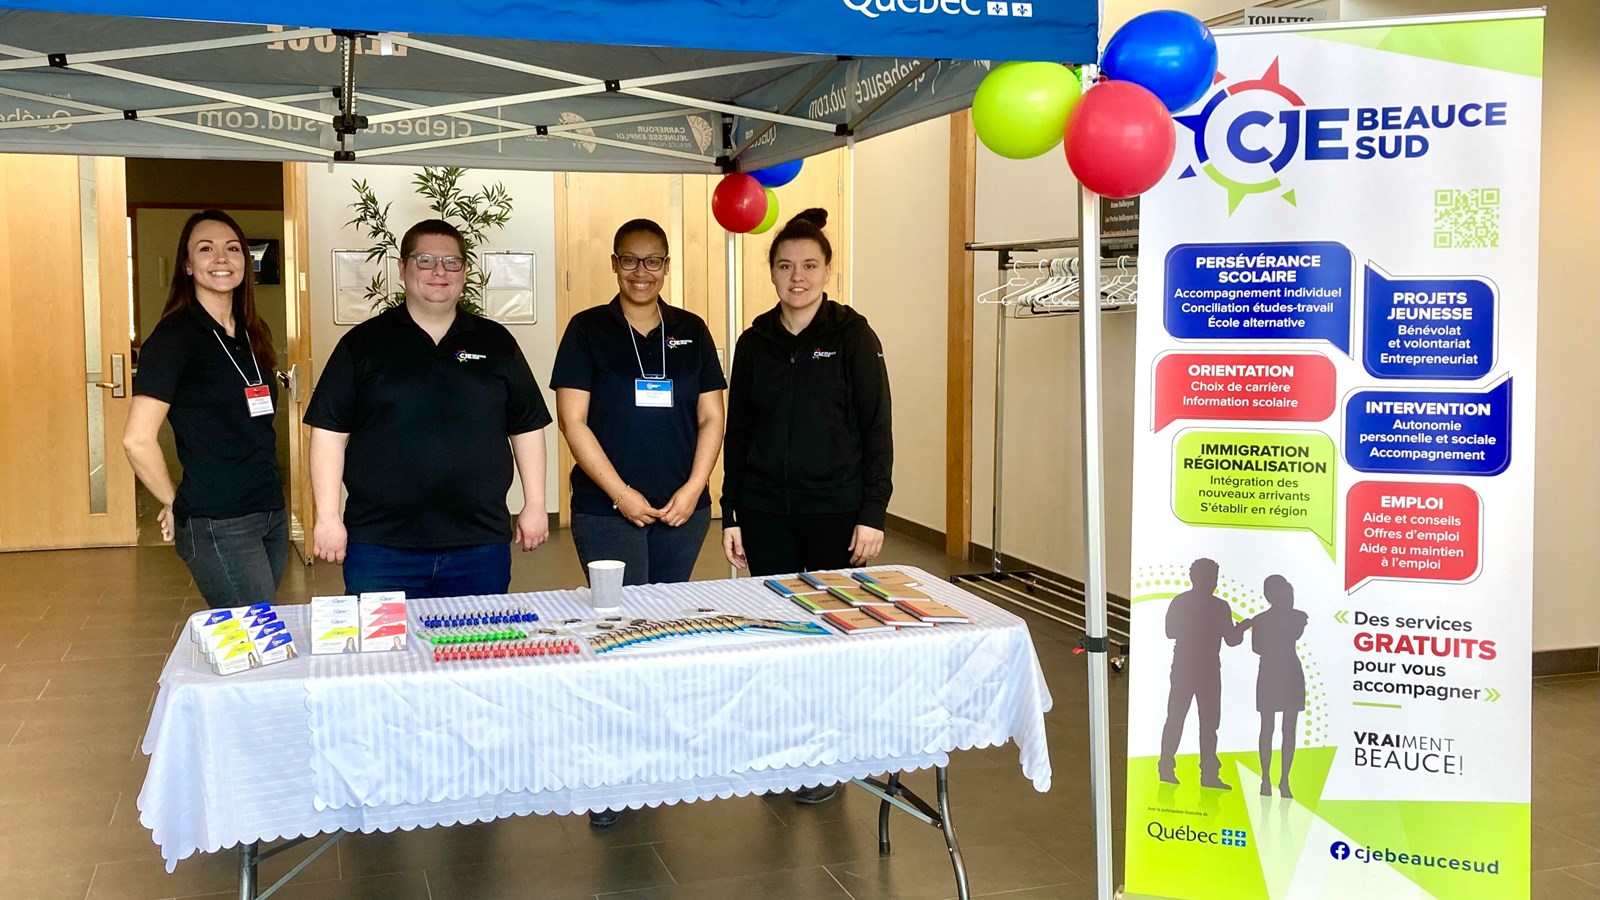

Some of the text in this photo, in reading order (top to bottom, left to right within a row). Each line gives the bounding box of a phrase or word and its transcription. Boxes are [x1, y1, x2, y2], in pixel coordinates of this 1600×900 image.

[1356, 101, 1507, 131] BEAUCE
[1226, 107, 1349, 174] CJE
[1355, 134, 1430, 160] SUD
[1195, 253, 1321, 269] PERSÉVÉRANCE
[1218, 269, 1297, 284] SCOLAIRE
[1174, 286, 1342, 300] Accompagnement individuel
[1393, 292, 1468, 306] PROJETS
[1181, 300, 1334, 314] Conciliation études-travail
[1387, 306, 1473, 321] JEUNESSE
[1207, 315, 1306, 328] École alternative
[1397, 323, 1462, 336] Bénévolat
[1388, 338, 1471, 349] et volontariat
[1380, 352, 1479, 366] Entrepreneuriat
[1188, 364, 1294, 378] ORIENTATION
[1190, 380, 1291, 393] Choix de carrière
[1182, 396, 1299, 409] Information scolaire
[1365, 401, 1491, 416] INTERVENTION
[1392, 419, 1462, 431] Autonomie
[1359, 432, 1496, 446] personnelle et sociale
[1200, 443, 1310, 459] IMMIGRATION
[1369, 447, 1485, 461] Accompagnement
[1183, 455, 1327, 474] RÉGIONALISATION
[1210, 475, 1299, 490] Intégration des
[1198, 489, 1310, 502] nouveaux arrivants
[1380, 495, 1444, 510] EMPLOI
[1200, 502, 1308, 518] S'établir en région
[1362, 512, 1462, 526] Aide et conseils
[1363, 527, 1460, 543] Offres d'emploi
[1359, 542, 1464, 557] Aide au maintien
[1380, 556, 1441, 571] à l'emploi
[1354, 611, 1390, 627] Des
[1395, 615, 1473, 632] services
[1353, 632, 1498, 661] GRATUITS
[1353, 660, 1447, 677] pour vous
[1353, 731, 1455, 752] VRAIMENT
[1353, 747, 1464, 776] BEAUCE!
[1147, 821, 1219, 845] Québec
[1354, 843, 1500, 875] cjebeaucesud
